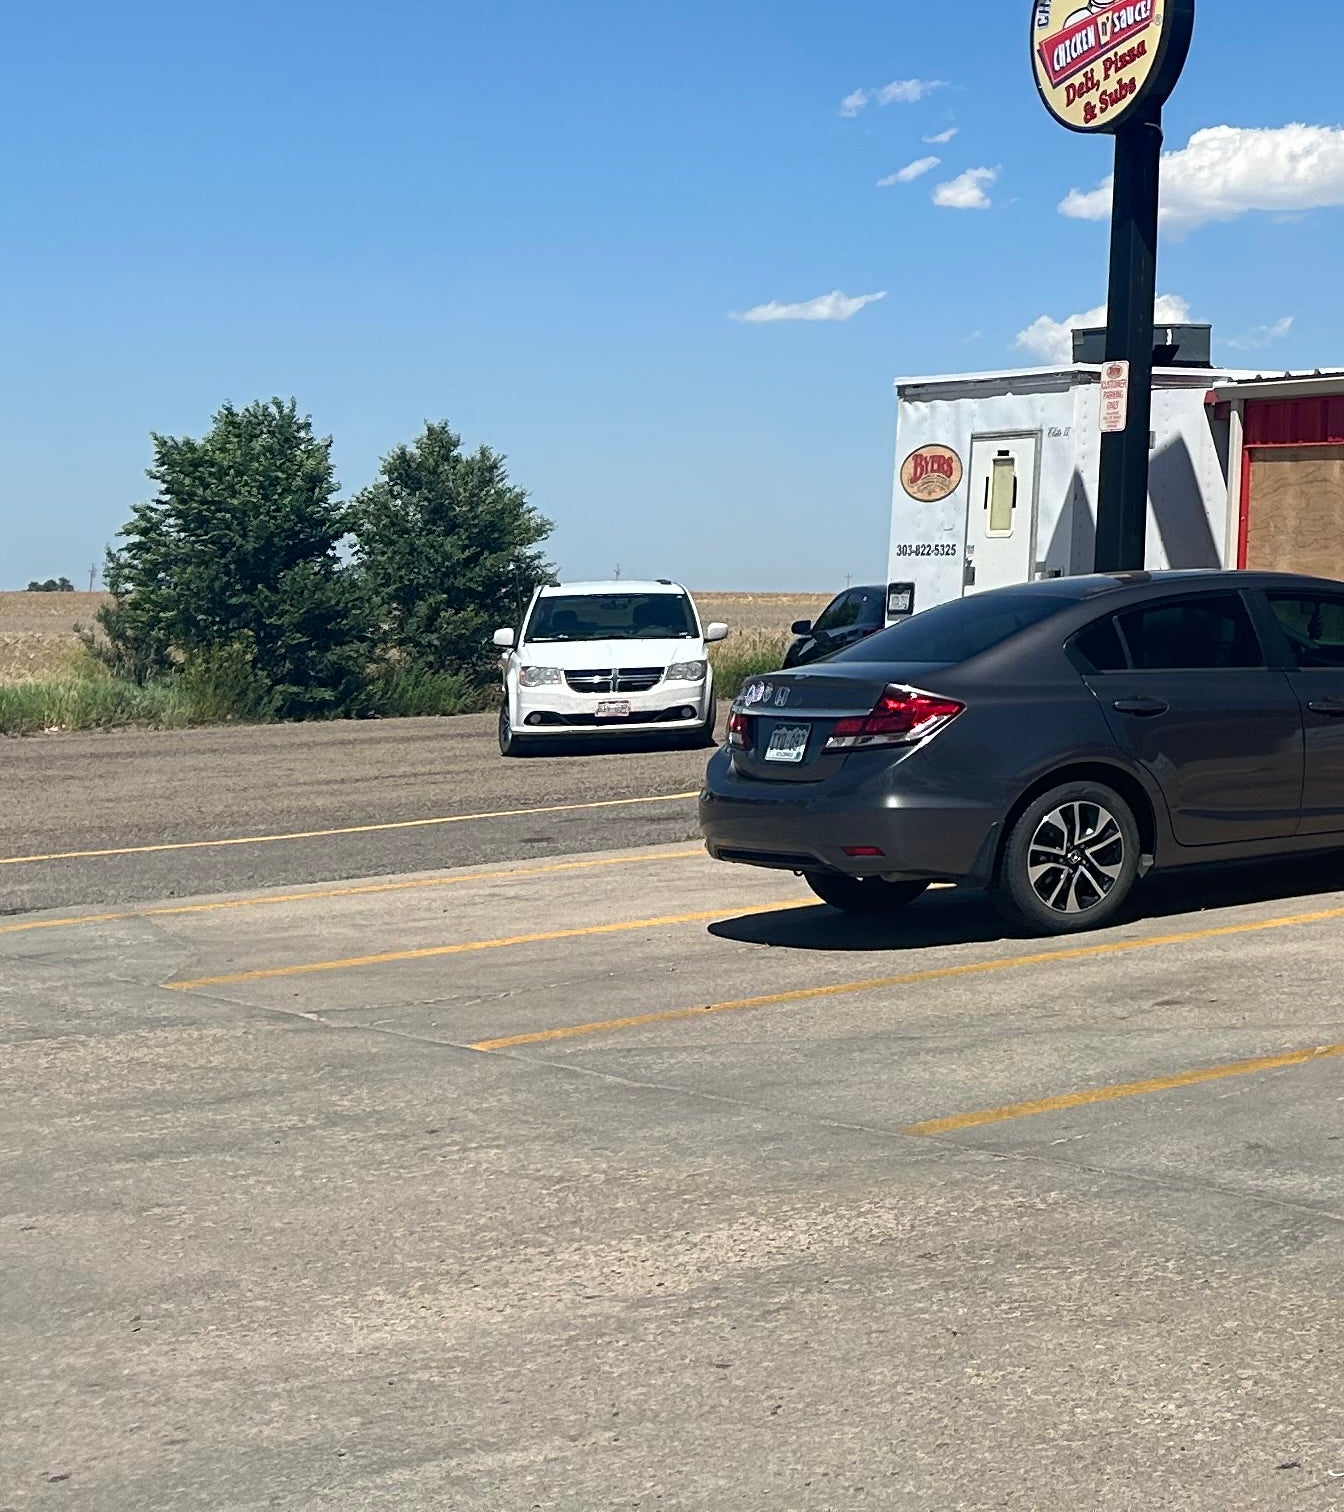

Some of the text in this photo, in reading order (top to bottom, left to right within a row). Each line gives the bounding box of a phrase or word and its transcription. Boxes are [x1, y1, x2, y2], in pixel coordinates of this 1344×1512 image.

[1053, 24, 1096, 71] CHICKEN
[1064, 39, 1147, 107] Deli, Pizza
[1083, 76, 1137, 124] & Subs
[909, 453, 953, 484] BYERS
[896, 544, 957, 557] 303-822-5325
